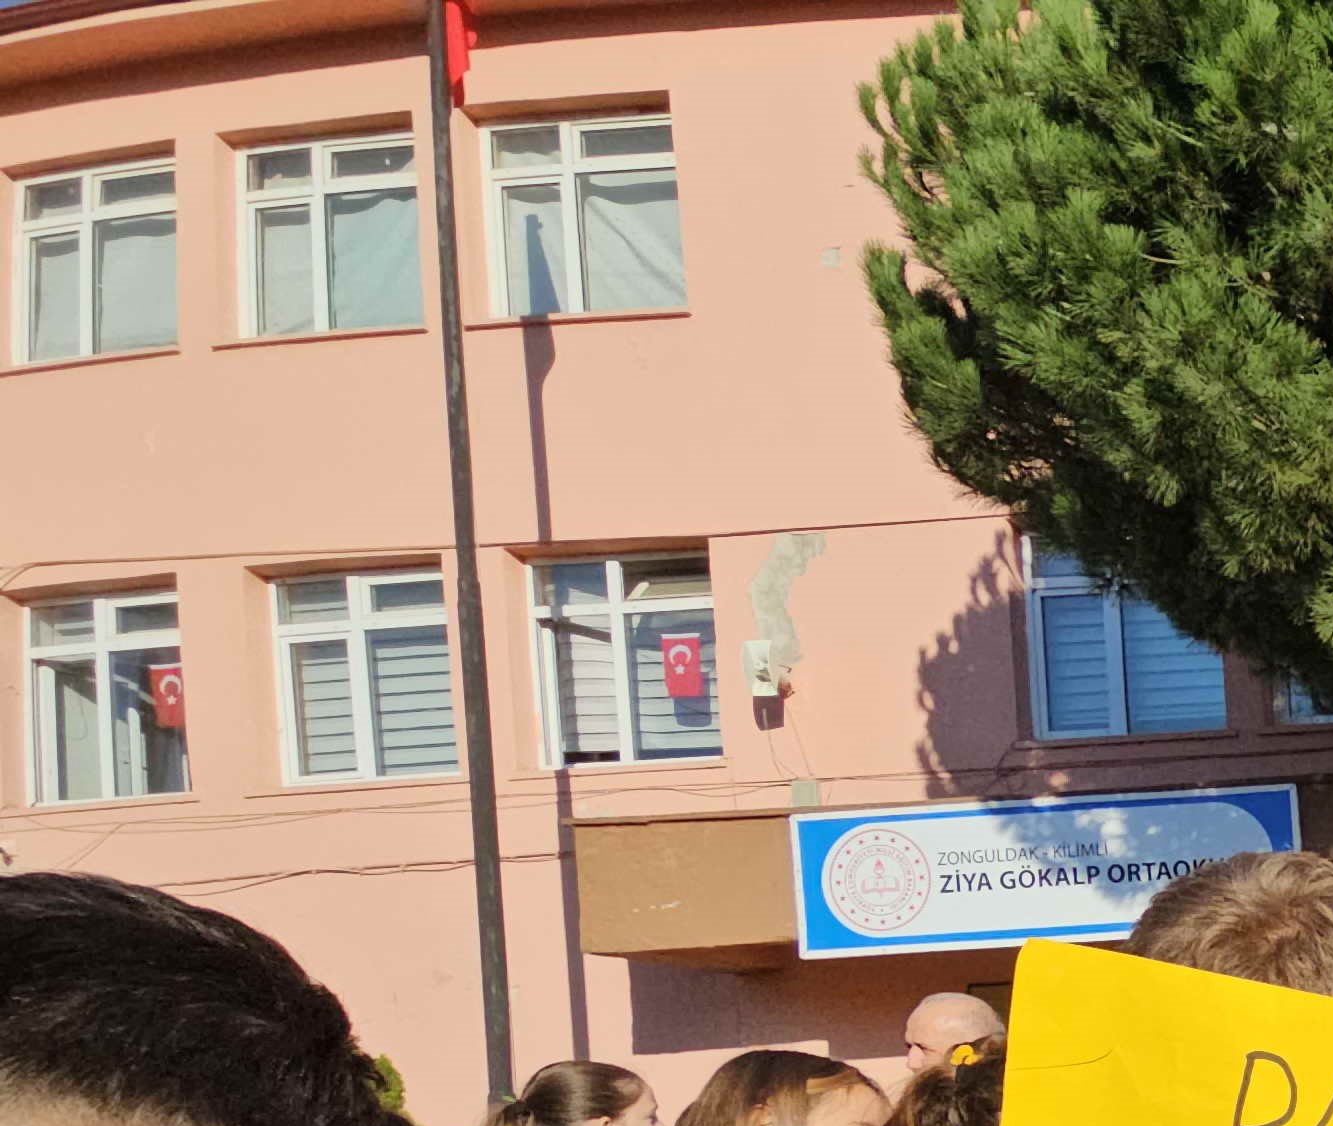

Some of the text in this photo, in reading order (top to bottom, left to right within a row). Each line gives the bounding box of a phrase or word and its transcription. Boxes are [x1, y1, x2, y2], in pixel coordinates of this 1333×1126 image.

[937, 845, 1040, 866] ZONGULDAK
[1053, 840, 1109, 859] KİLİMLİ
[939, 857, 1225, 894] ZİYA GÖKALP ORTAOK
